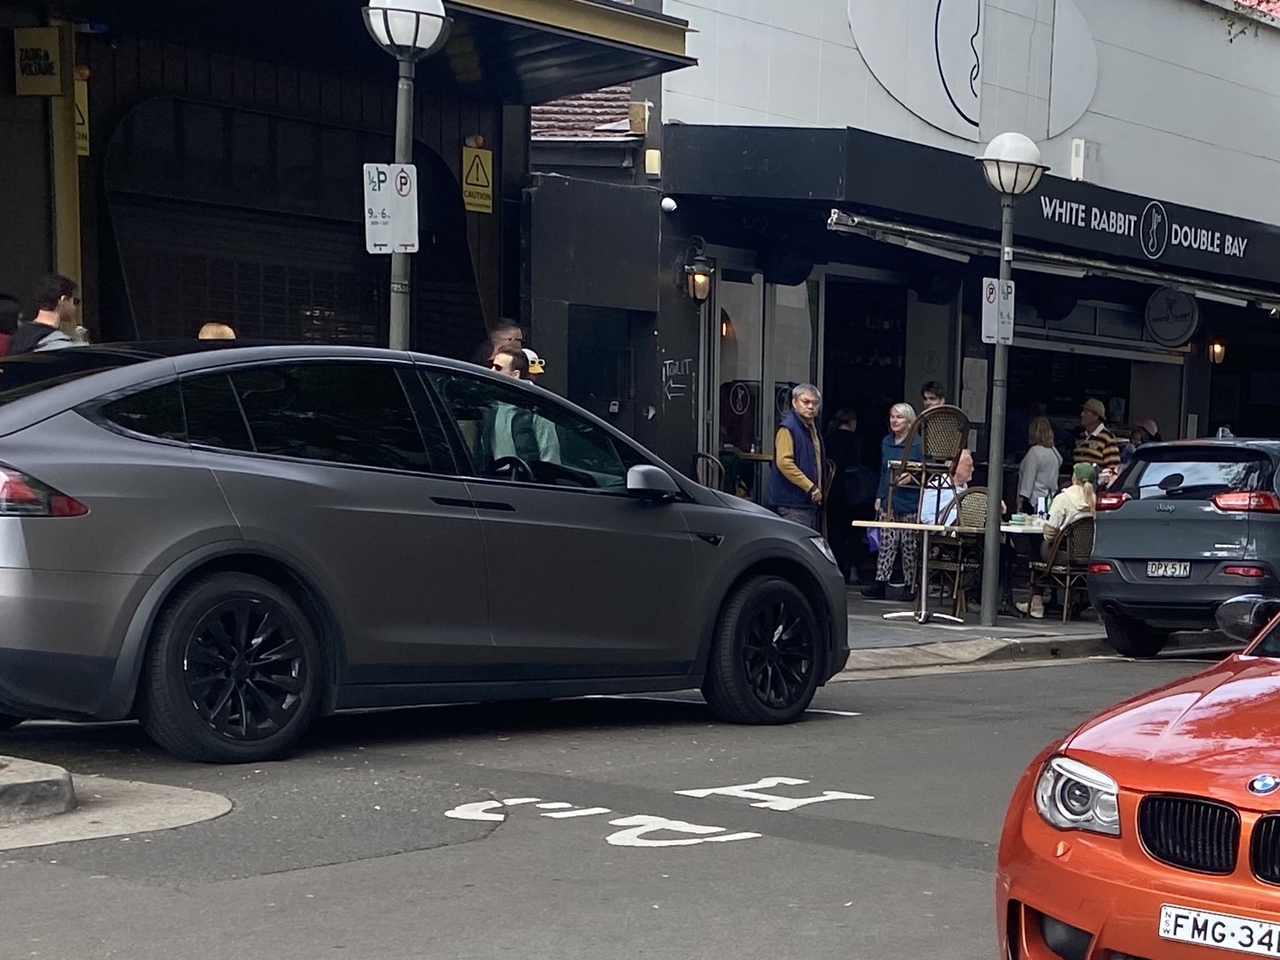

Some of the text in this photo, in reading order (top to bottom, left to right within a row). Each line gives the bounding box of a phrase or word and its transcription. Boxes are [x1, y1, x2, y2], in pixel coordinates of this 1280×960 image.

[464, 190, 491, 201] CAUTION
[1040, 196, 1248, 258] WHITE RABBIT DOUBLE BAY
[1156, 503, 1175, 513] Jeep
